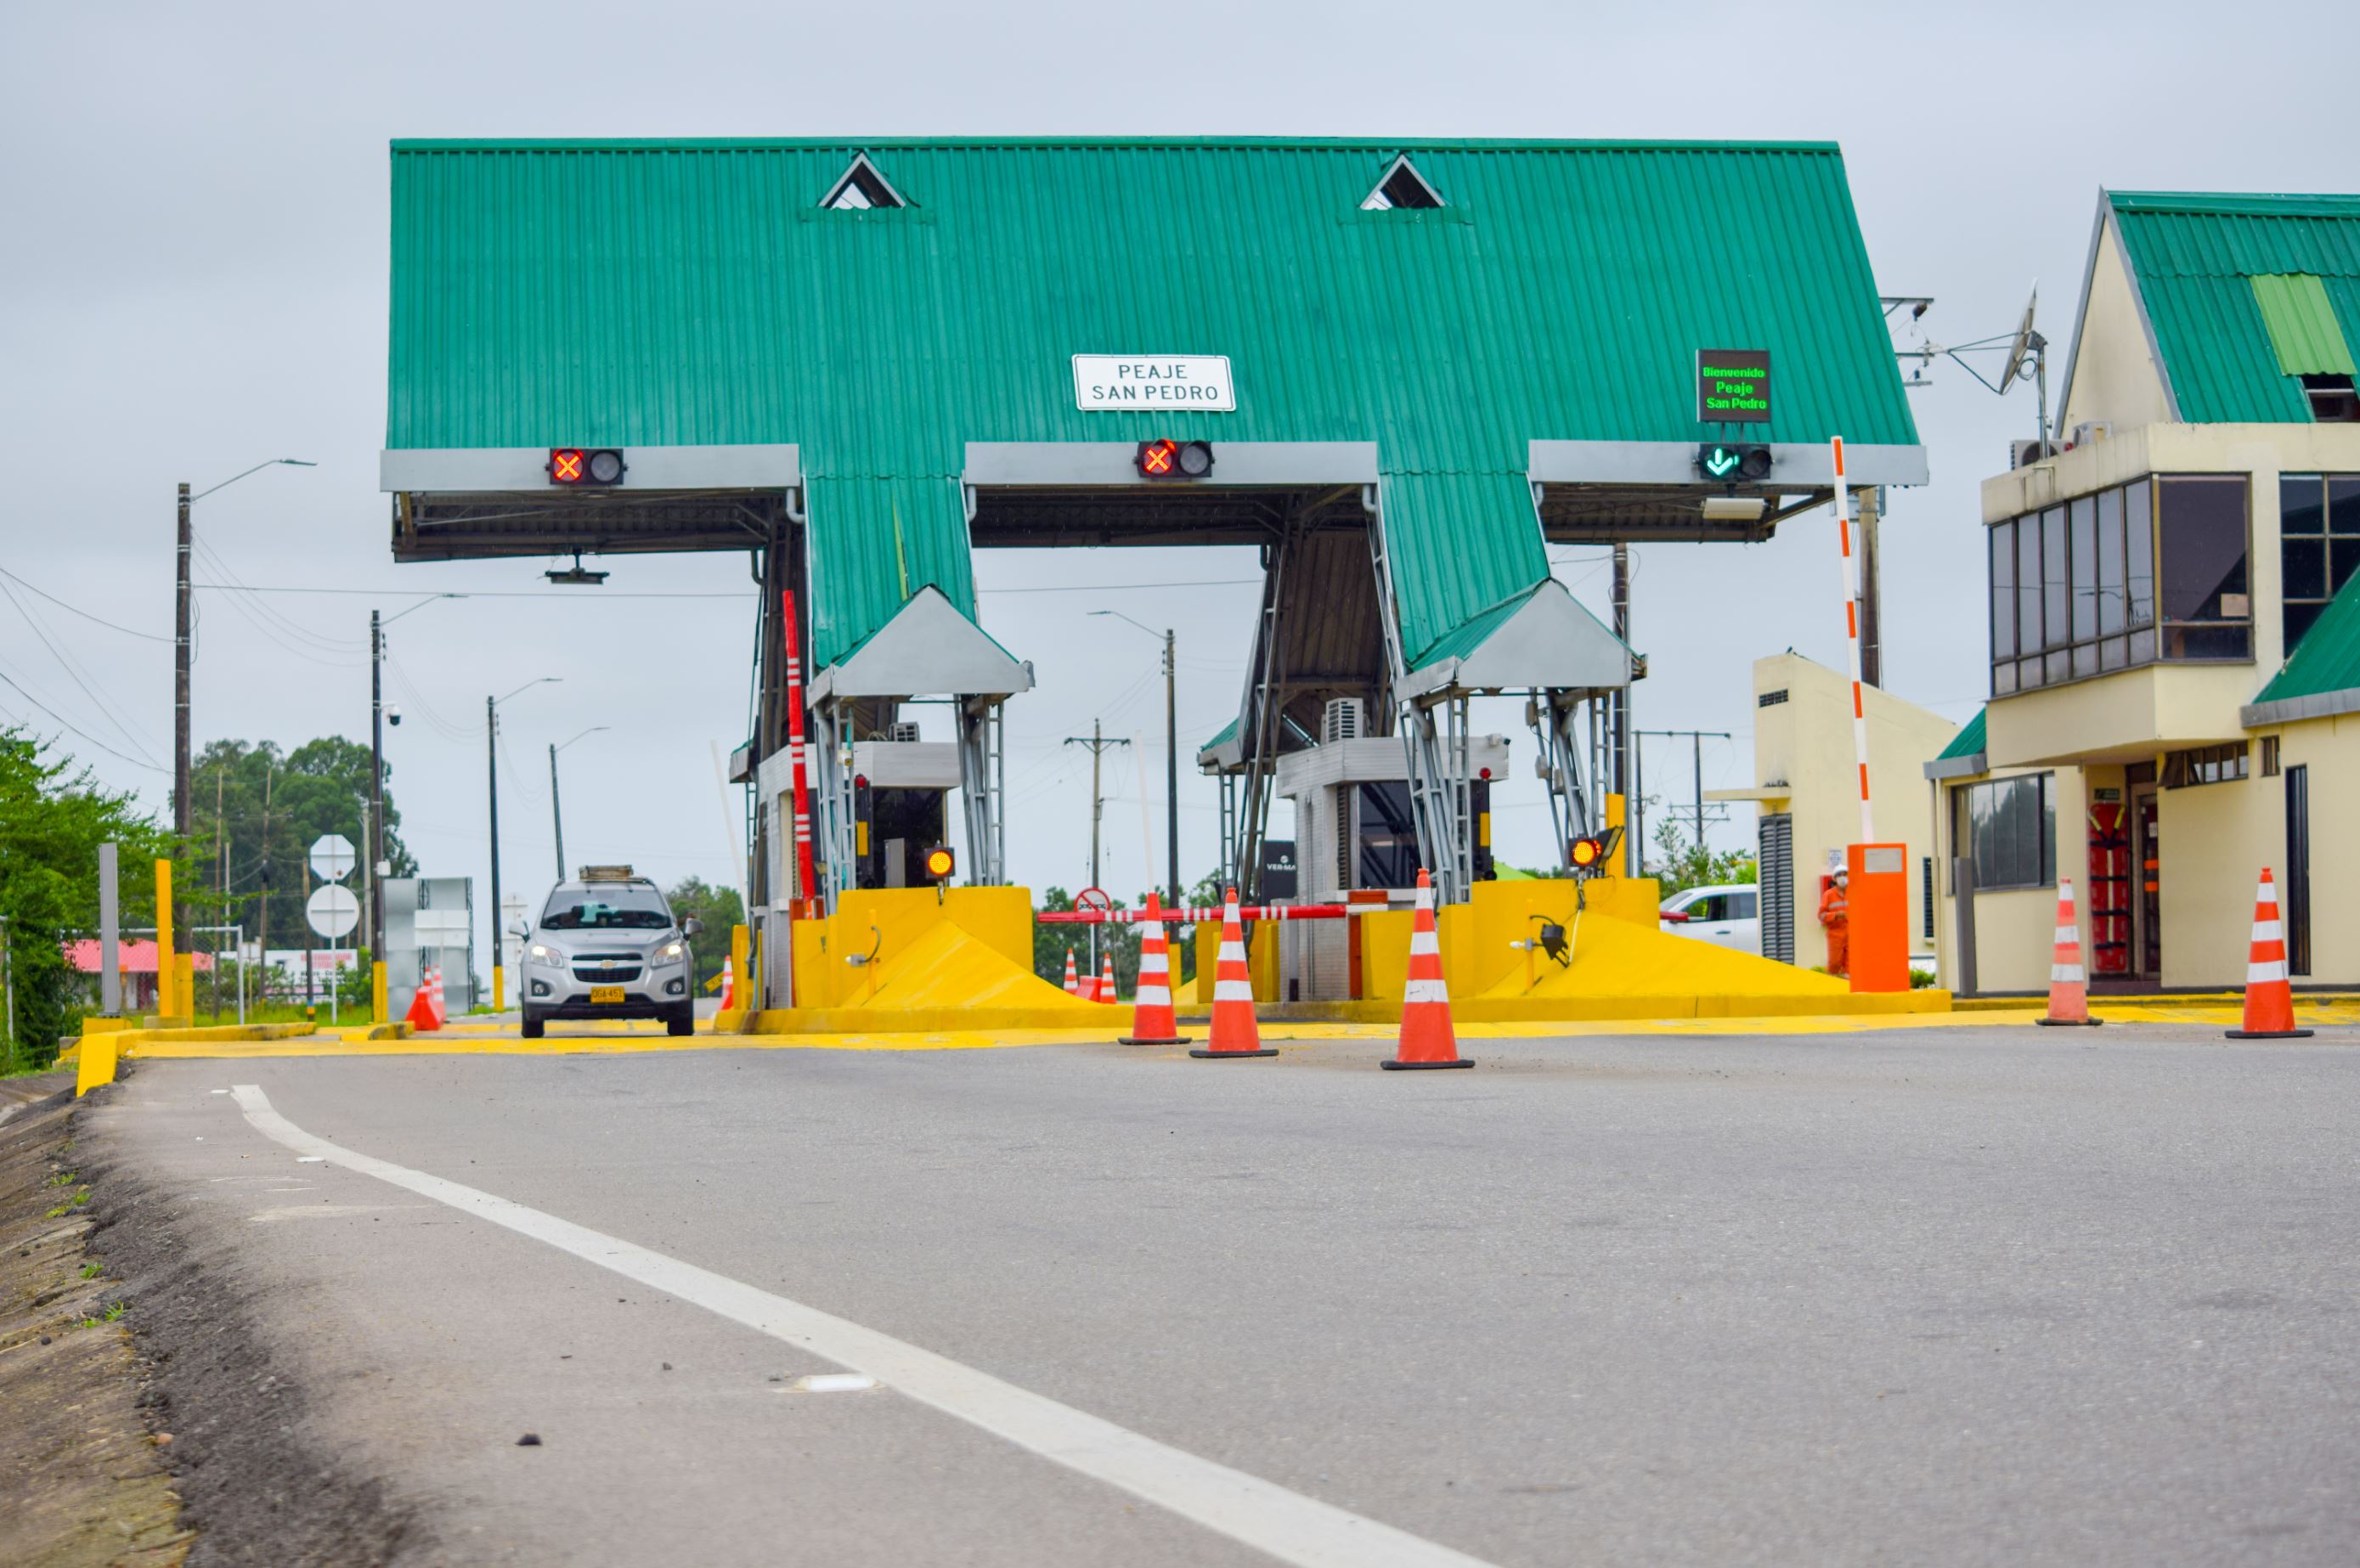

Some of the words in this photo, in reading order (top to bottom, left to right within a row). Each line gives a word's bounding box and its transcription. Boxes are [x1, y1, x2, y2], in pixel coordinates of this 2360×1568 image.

[1118, 364, 1188, 379] PEAJE
[1702, 367, 1765, 378] Bienvenido
[1092, 386, 1137, 400] SAN
[1144, 386, 1218, 400] PEDRO
[1716, 381, 1753, 397] Peaje
[1706, 397, 1729, 409] San
[1731, 397, 1768, 409] Pedro
